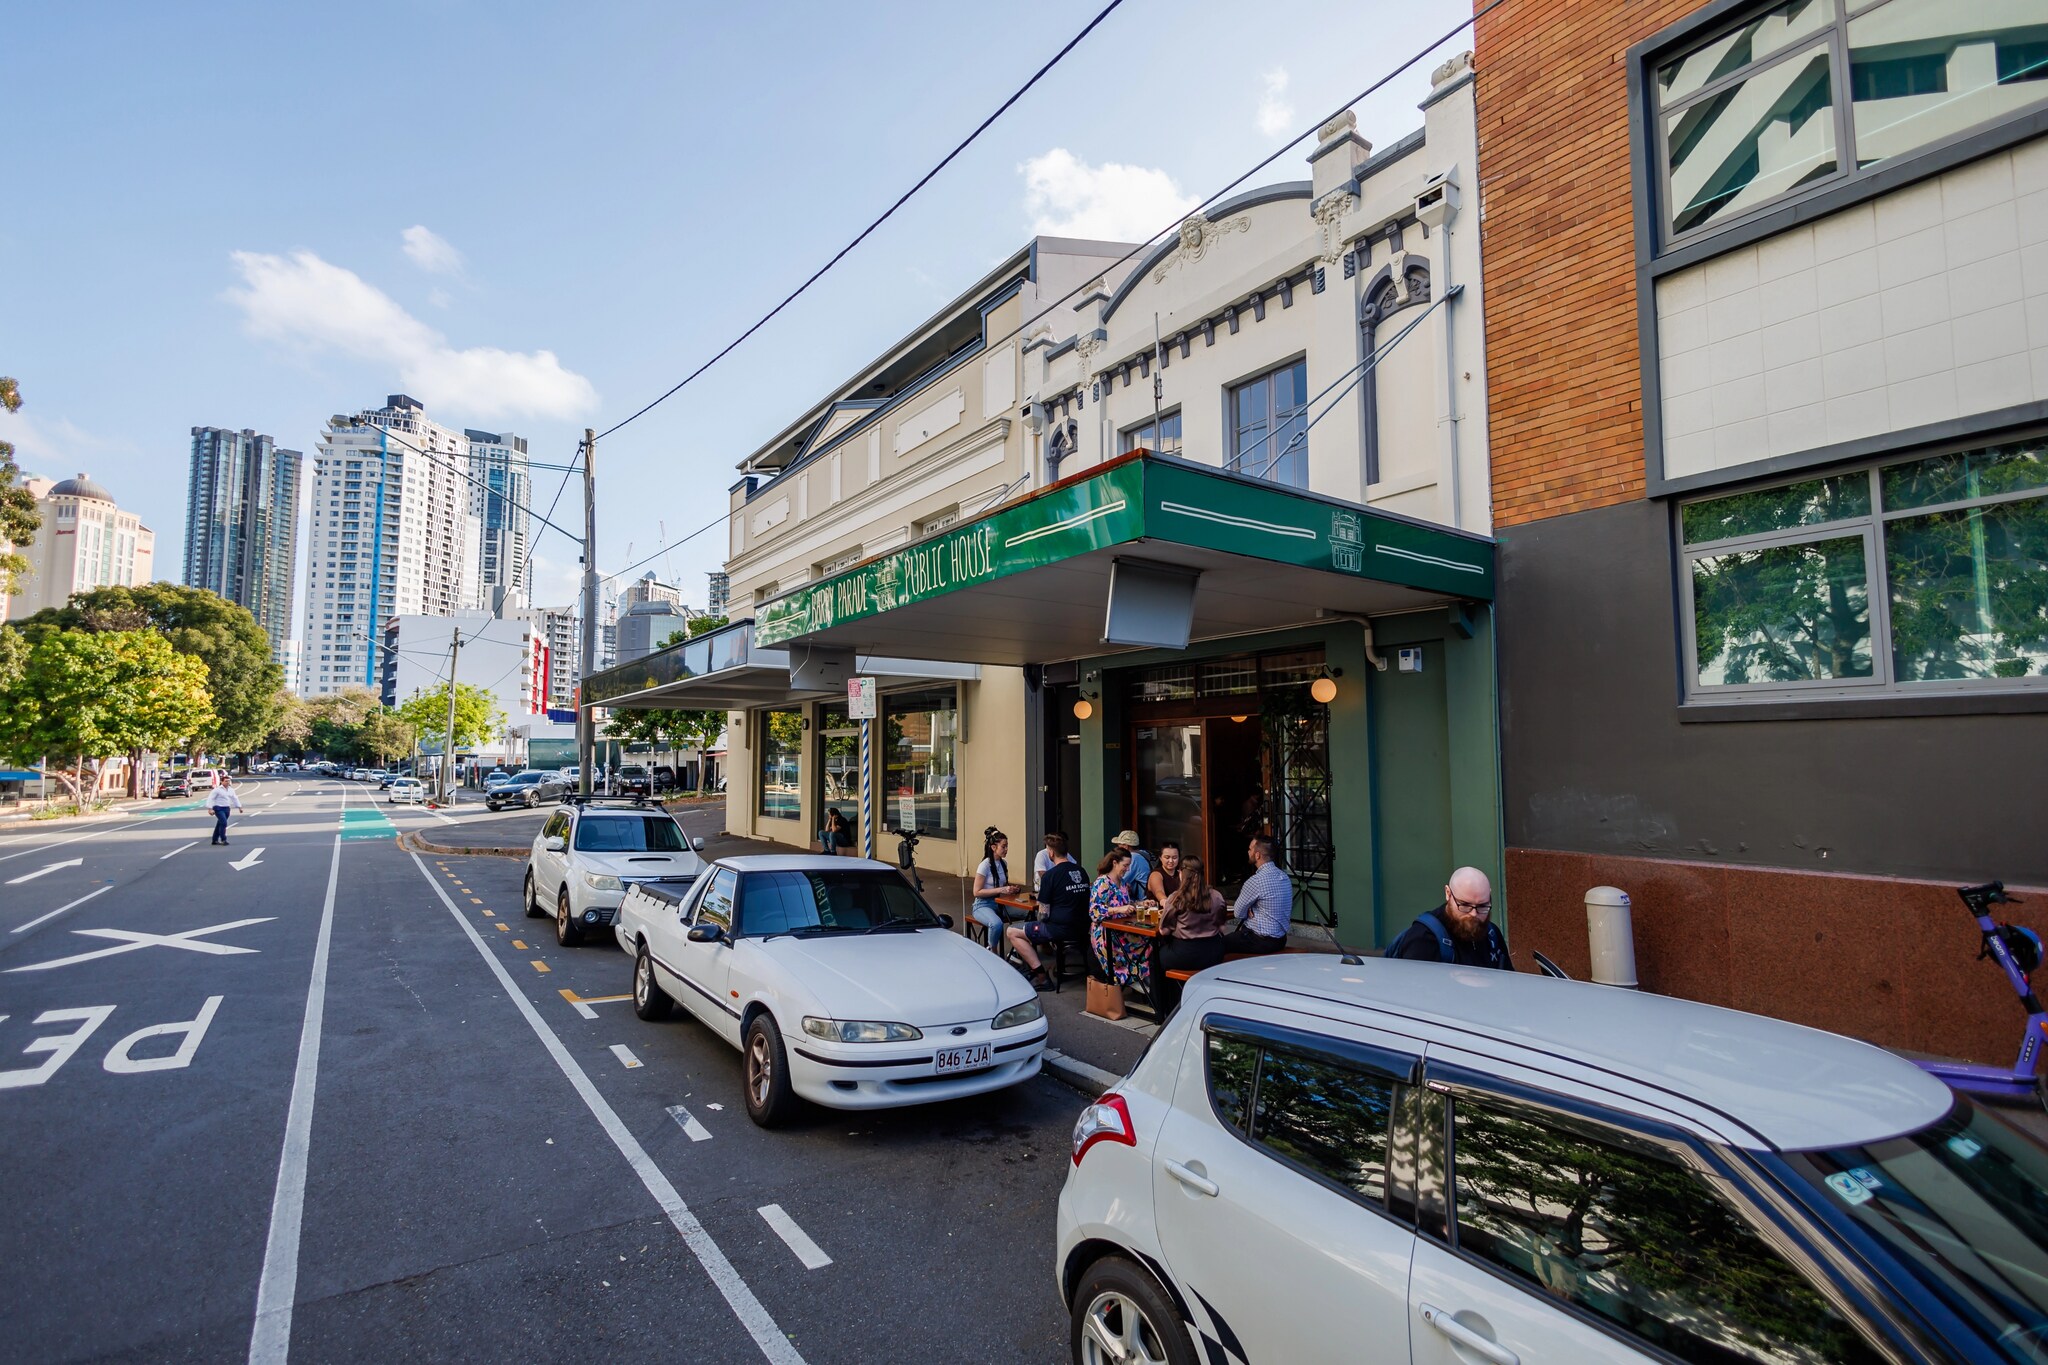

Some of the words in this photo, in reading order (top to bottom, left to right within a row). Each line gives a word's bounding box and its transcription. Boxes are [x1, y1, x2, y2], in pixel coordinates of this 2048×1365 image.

[811, 585, 834, 627] BARRY
[837, 572, 868, 619] PARADE
[904, 543, 947, 603] PUBLIC
[950, 526, 993, 583] HOUSE
[1989, 935, 2006, 956] beam
[0, 995, 224, 1089] PE
[938, 1051, 961, 1068] 846
[965, 1046, 989, 1065] ZJA
